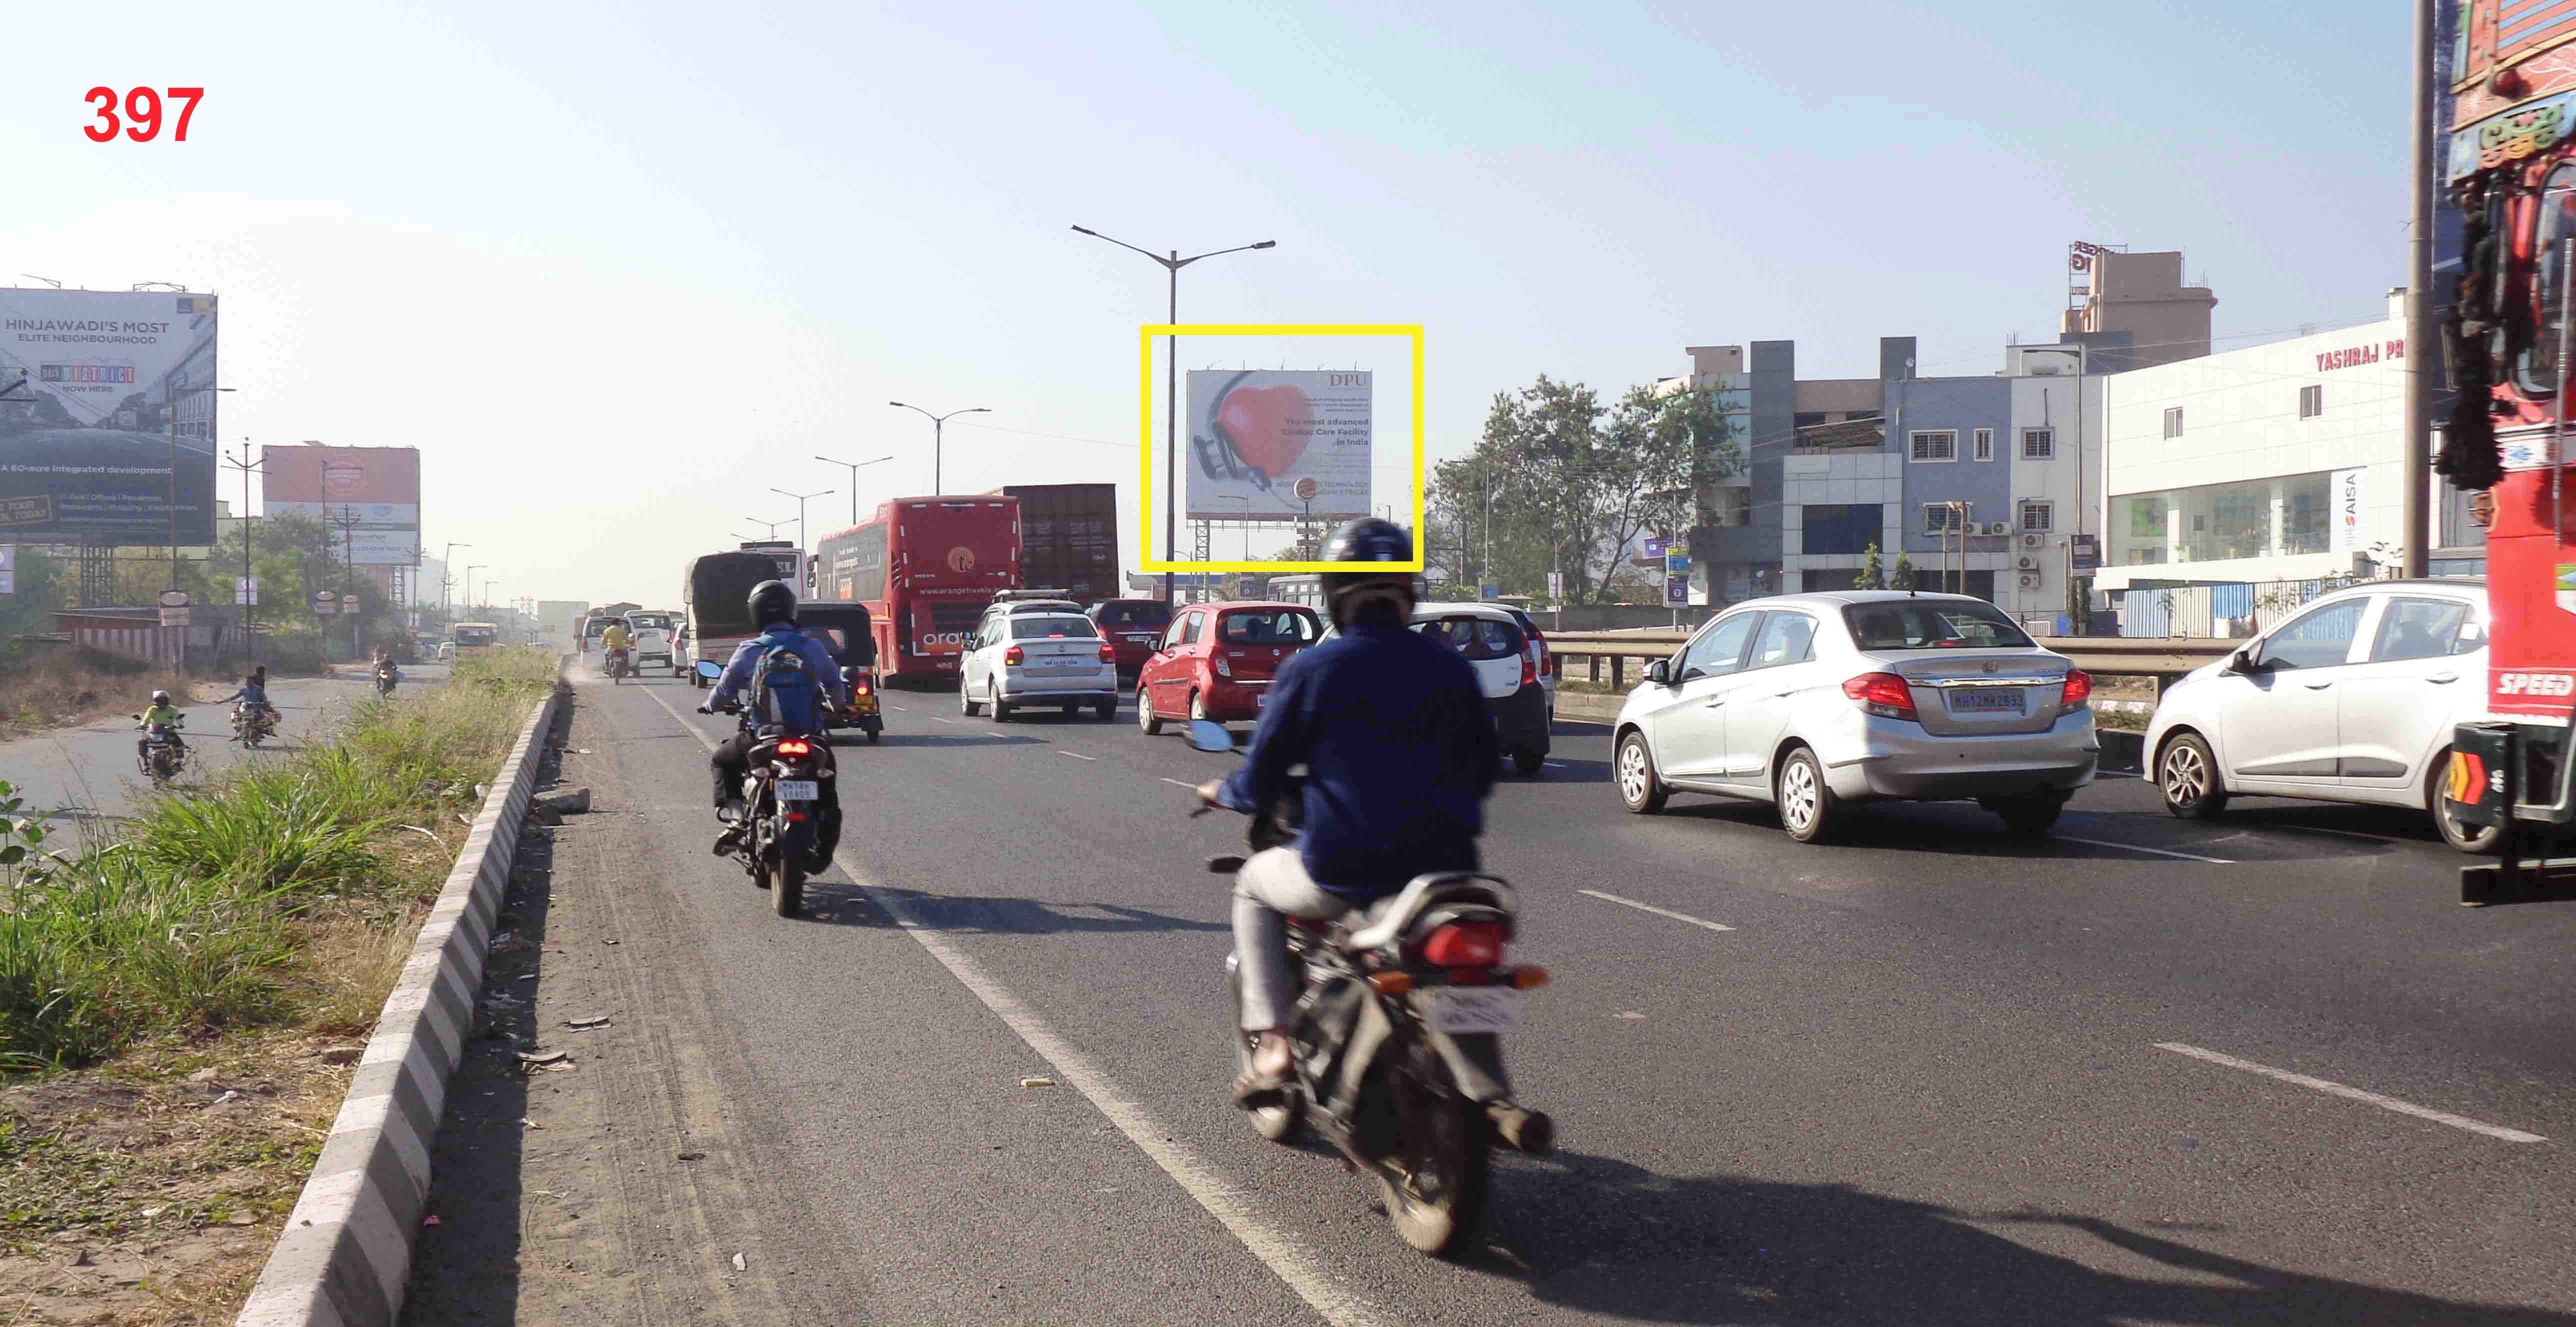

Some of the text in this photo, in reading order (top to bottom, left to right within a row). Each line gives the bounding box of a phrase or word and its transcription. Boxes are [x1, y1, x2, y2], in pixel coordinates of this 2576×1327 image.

[6, 319, 169, 333] HINJAWADI'S MOST
[18, 334, 156, 344] ELITE NEIGHBOURHOOD
[2316, 344, 2379, 372] YASHRAJ
[64, 366, 134, 382] DISTRICT
[1330, 374, 1368, 386] DPU
[1338, 428, 1368, 436] Facility
[0, 464, 9, 472] A
[108, 465, 172, 476] development
[923, 633, 960, 644] ora
[2496, 673, 2574, 696] SPEED
